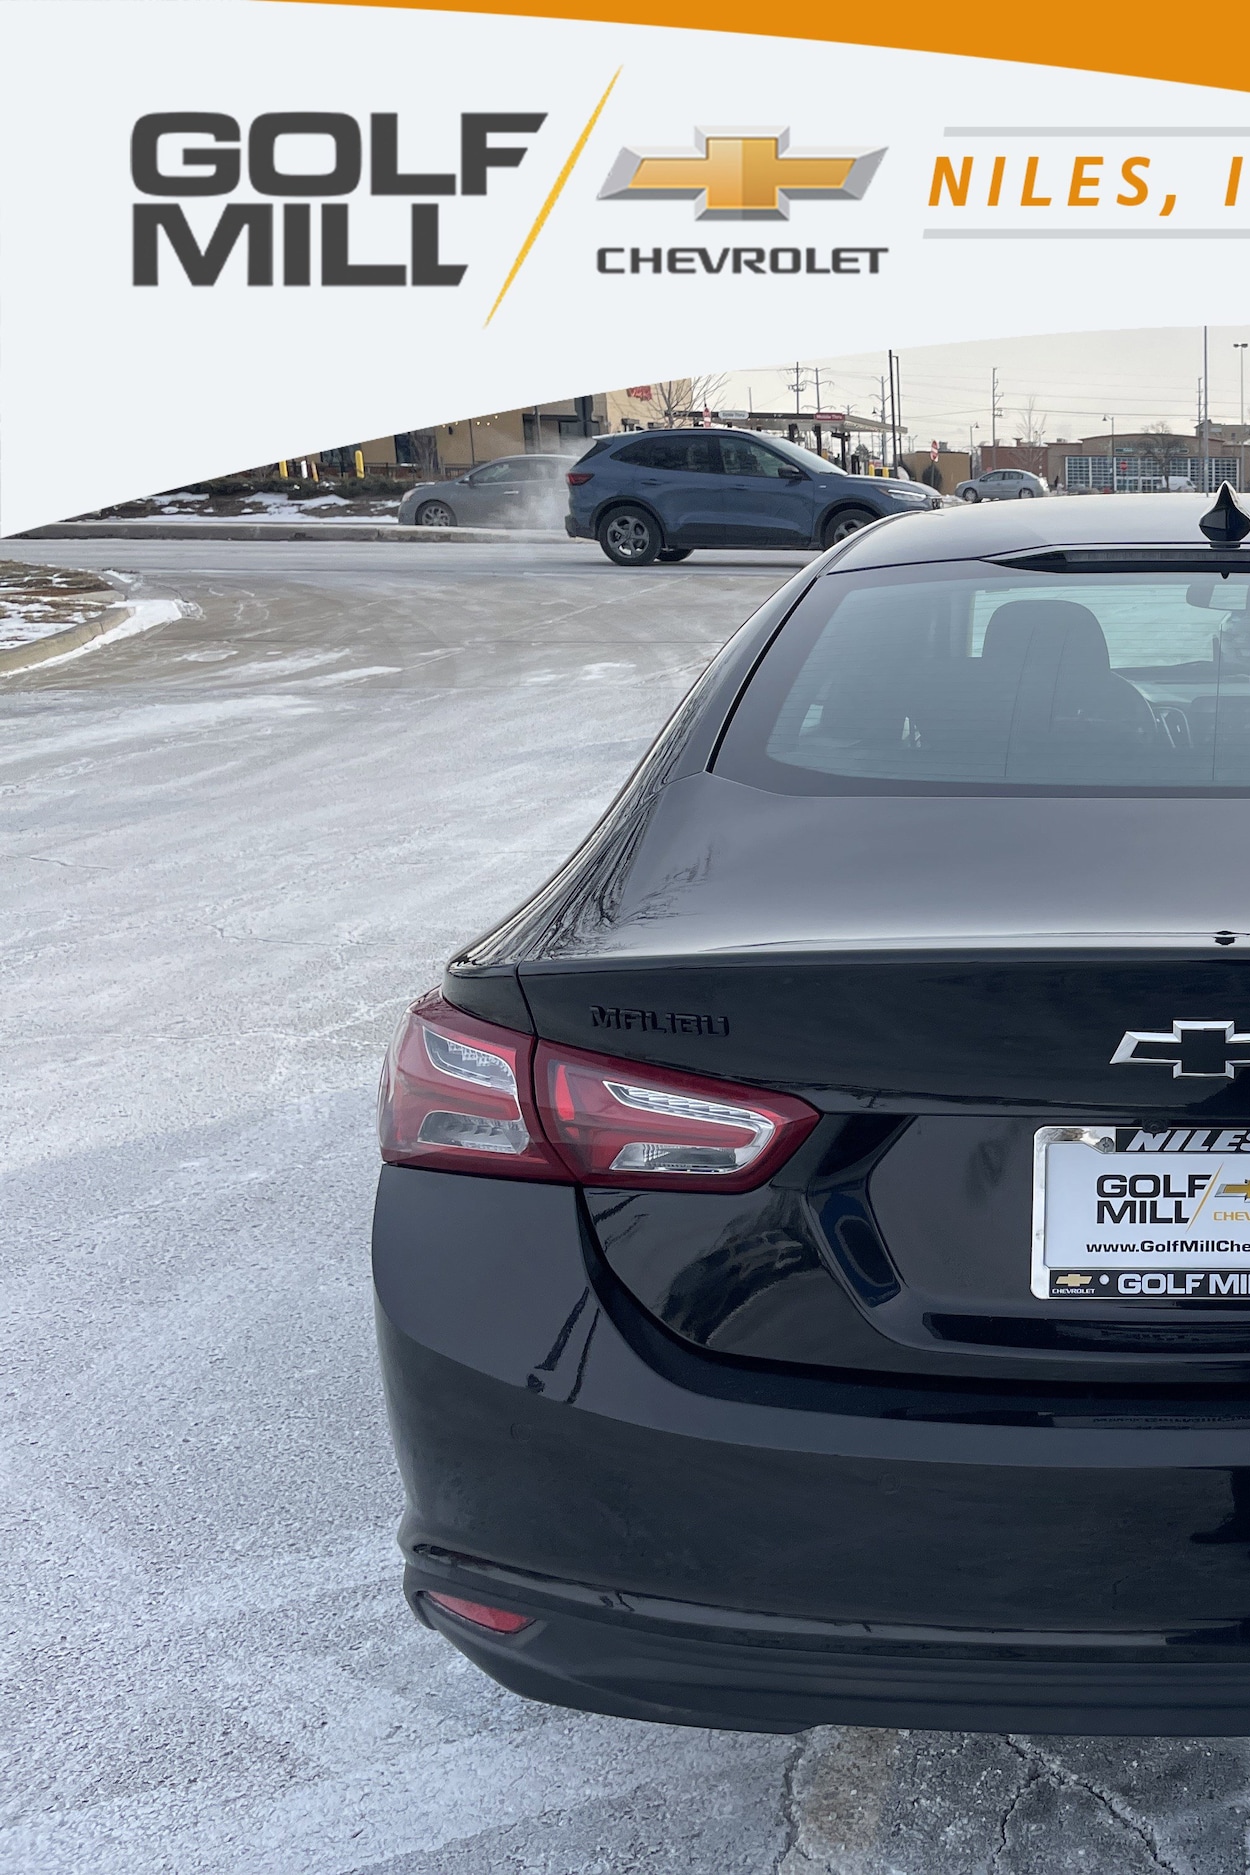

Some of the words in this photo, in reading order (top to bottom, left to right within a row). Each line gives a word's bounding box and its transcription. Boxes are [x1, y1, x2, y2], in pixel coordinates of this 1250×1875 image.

[590, 1005, 730, 1037] MALIBU
[1096, 1174, 1213, 1199] GOLF
[1096, 1200, 1190, 1225] MILL
[1051, 1287, 1096, 1295] CHEVROLET
[1117, 1273, 1205, 1295] GOLF
